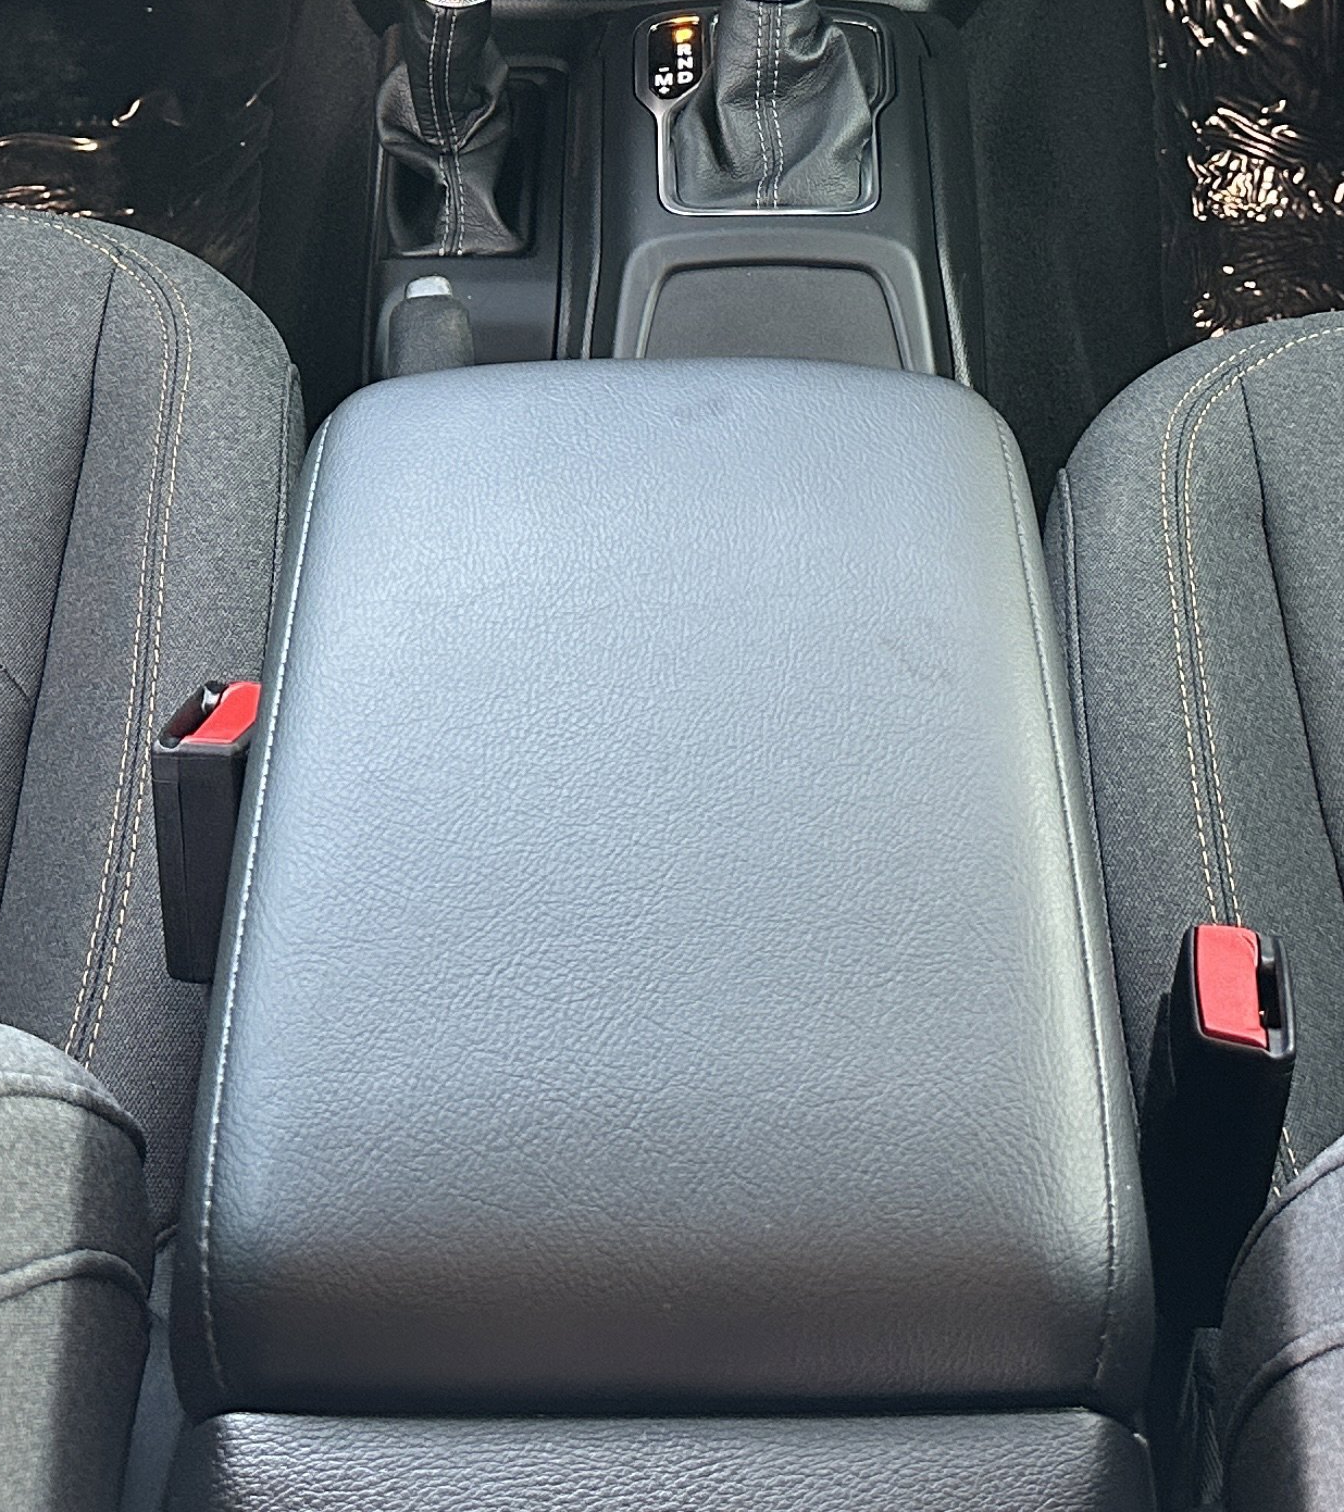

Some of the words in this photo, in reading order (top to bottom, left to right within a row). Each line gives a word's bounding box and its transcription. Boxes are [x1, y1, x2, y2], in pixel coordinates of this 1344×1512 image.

[677, 43, 692, 56] R
[677, 57, 694, 70] N
[655, 74, 674, 87] M
[677, 71, 694, 85] D
